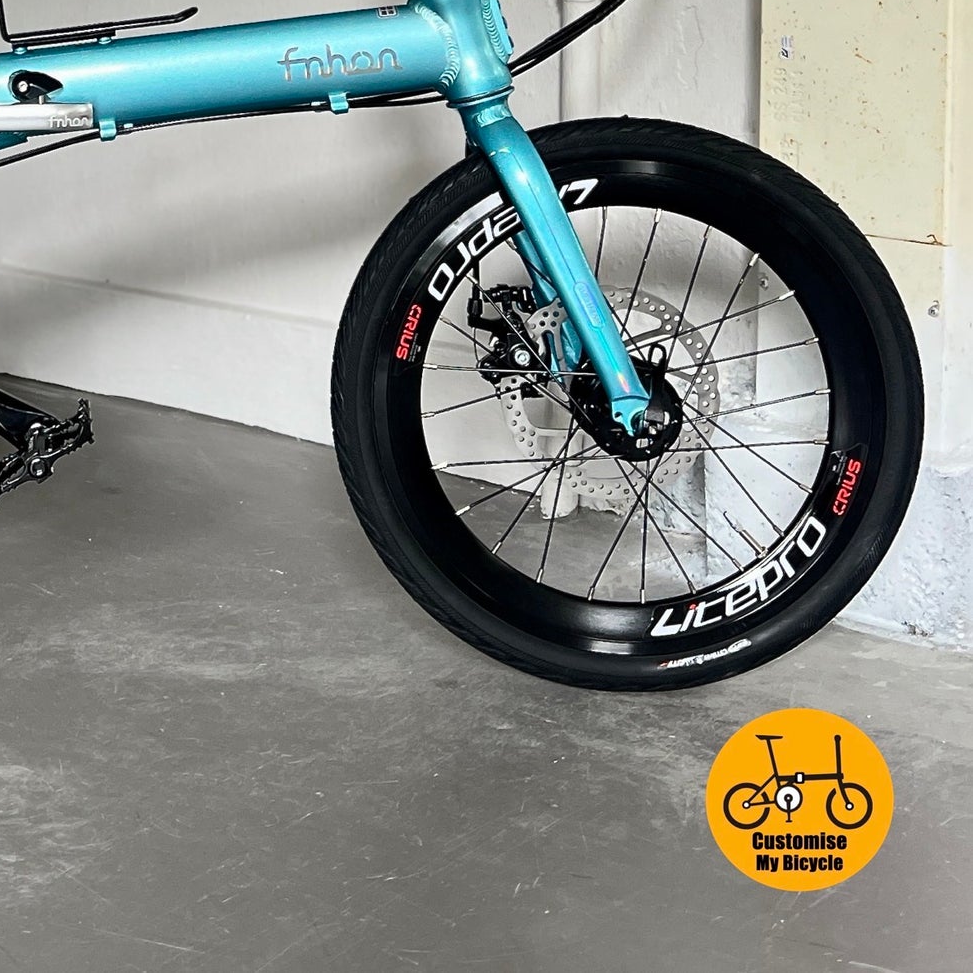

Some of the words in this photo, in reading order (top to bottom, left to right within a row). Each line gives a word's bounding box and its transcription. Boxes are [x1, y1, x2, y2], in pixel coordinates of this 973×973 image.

[277, 43, 403, 82] fnhon
[47, 114, 90, 128] fnhon
[396, 303, 423, 360] CRIUS
[832, 458, 862, 516] CRIUS
